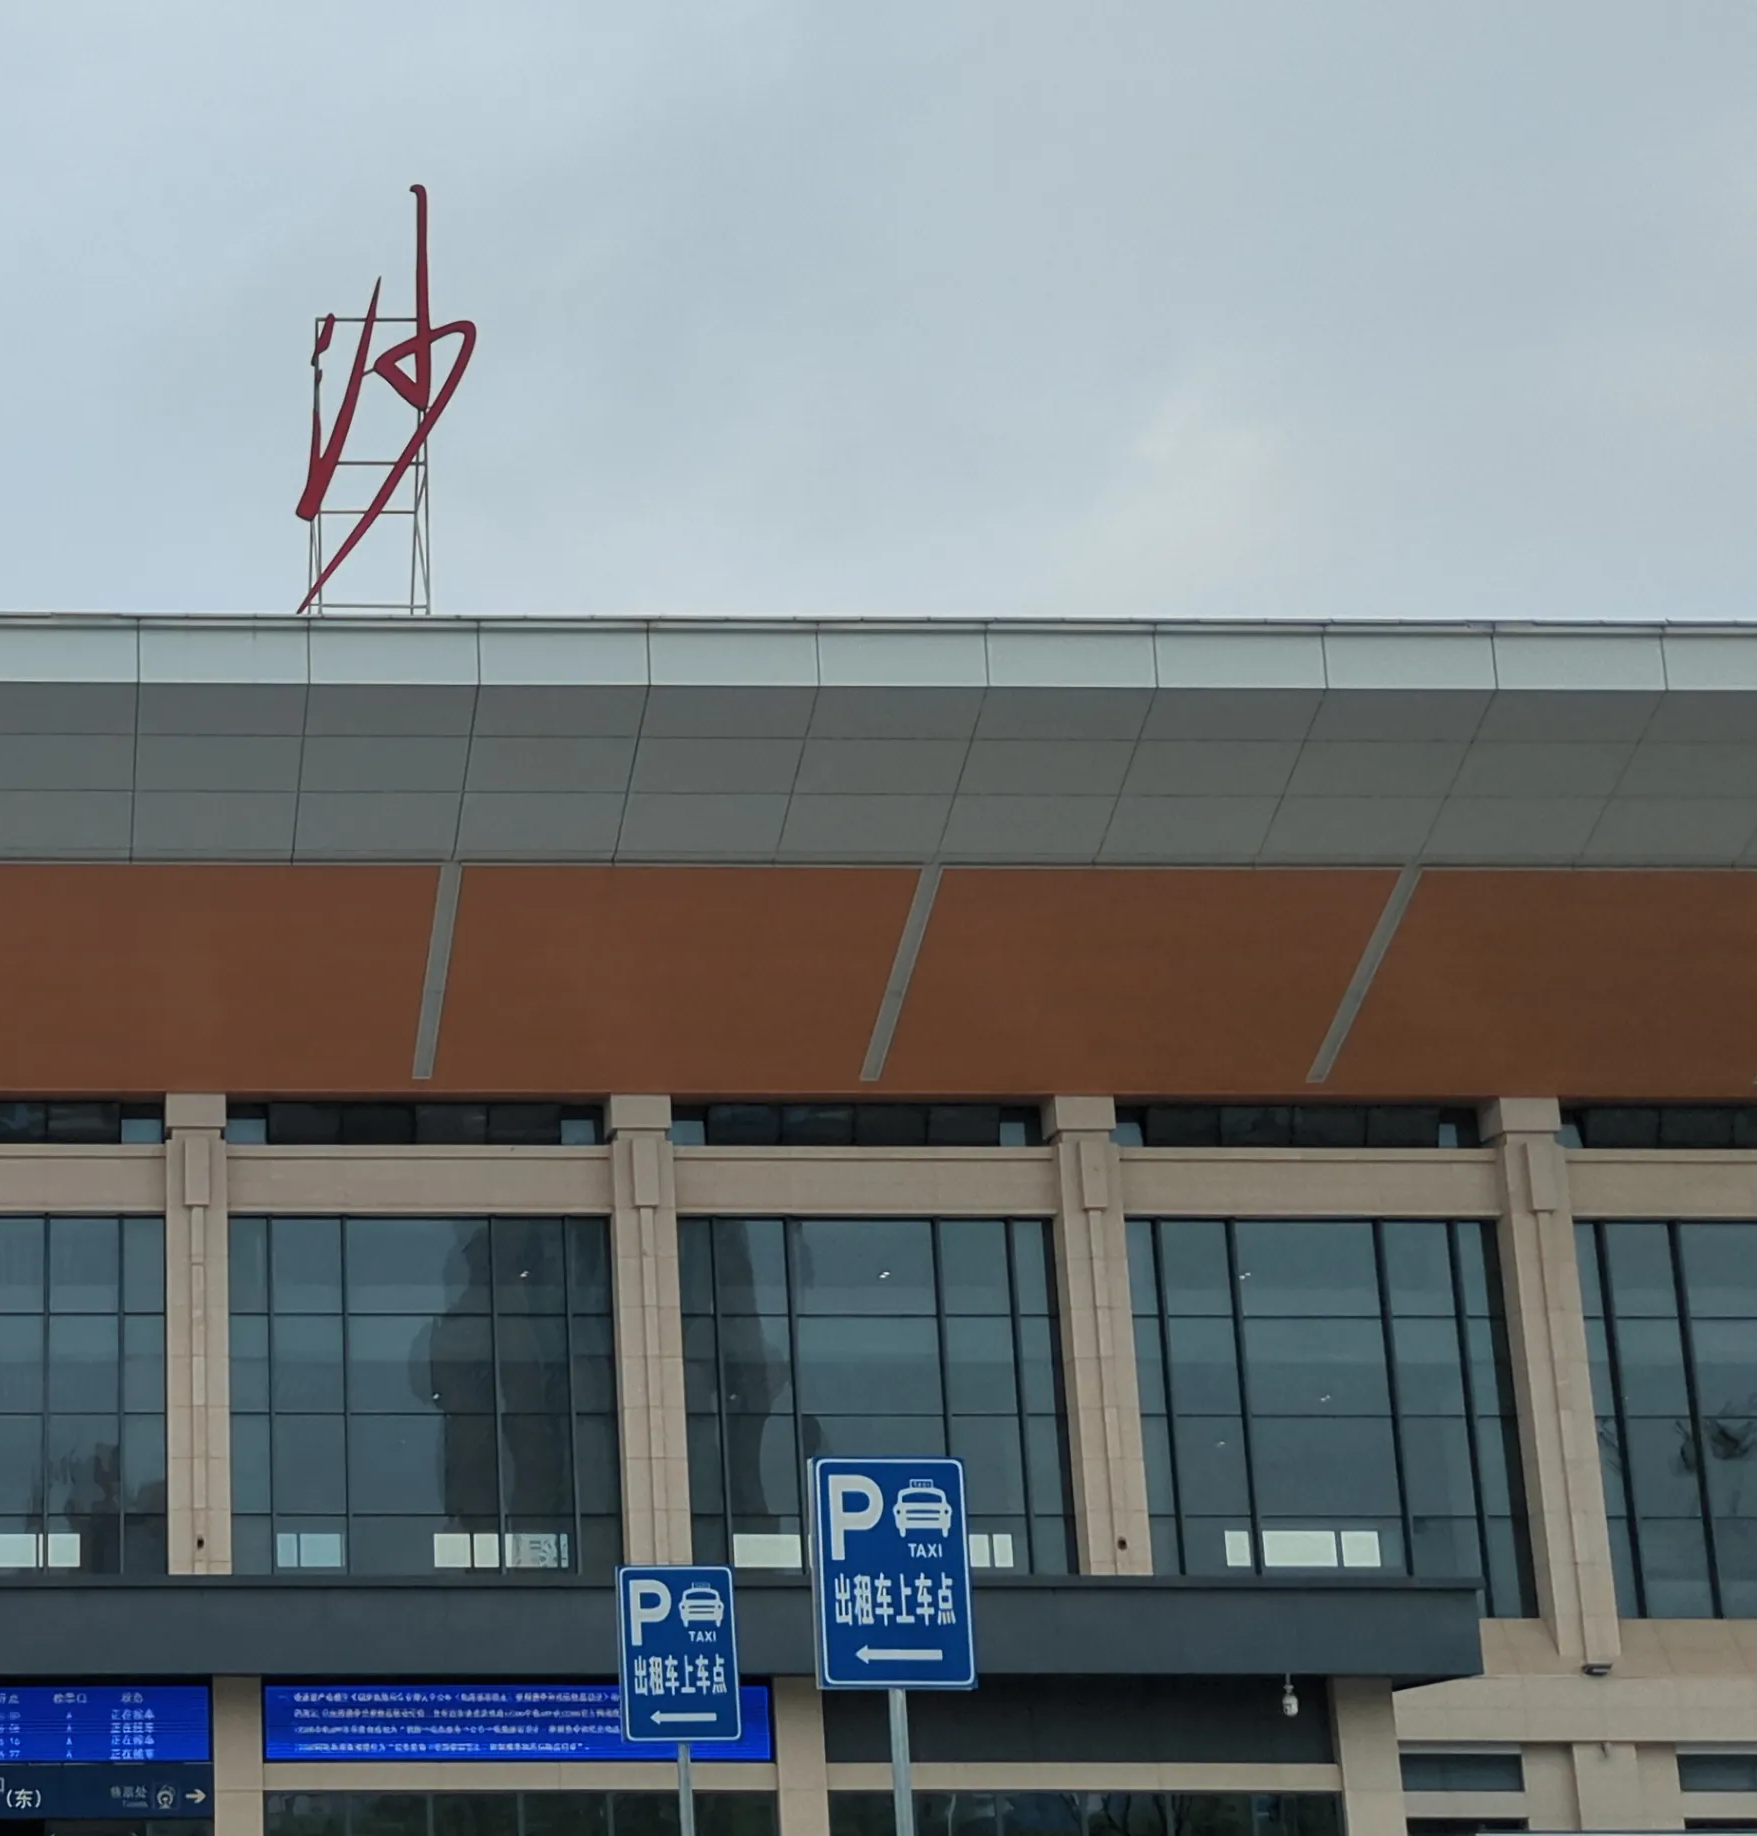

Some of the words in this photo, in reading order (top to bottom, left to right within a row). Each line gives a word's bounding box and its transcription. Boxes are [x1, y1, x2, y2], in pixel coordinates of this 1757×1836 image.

[827, 1474, 884, 1561] P
[907, 1542, 943, 1559] TAXI
[628, 1579, 672, 1646] P
[834, 1572, 957, 1626] 出租车上车点
[688, 1630, 717, 1642] TAXI
[633, 1653, 727, 1696] 出租车上车点
